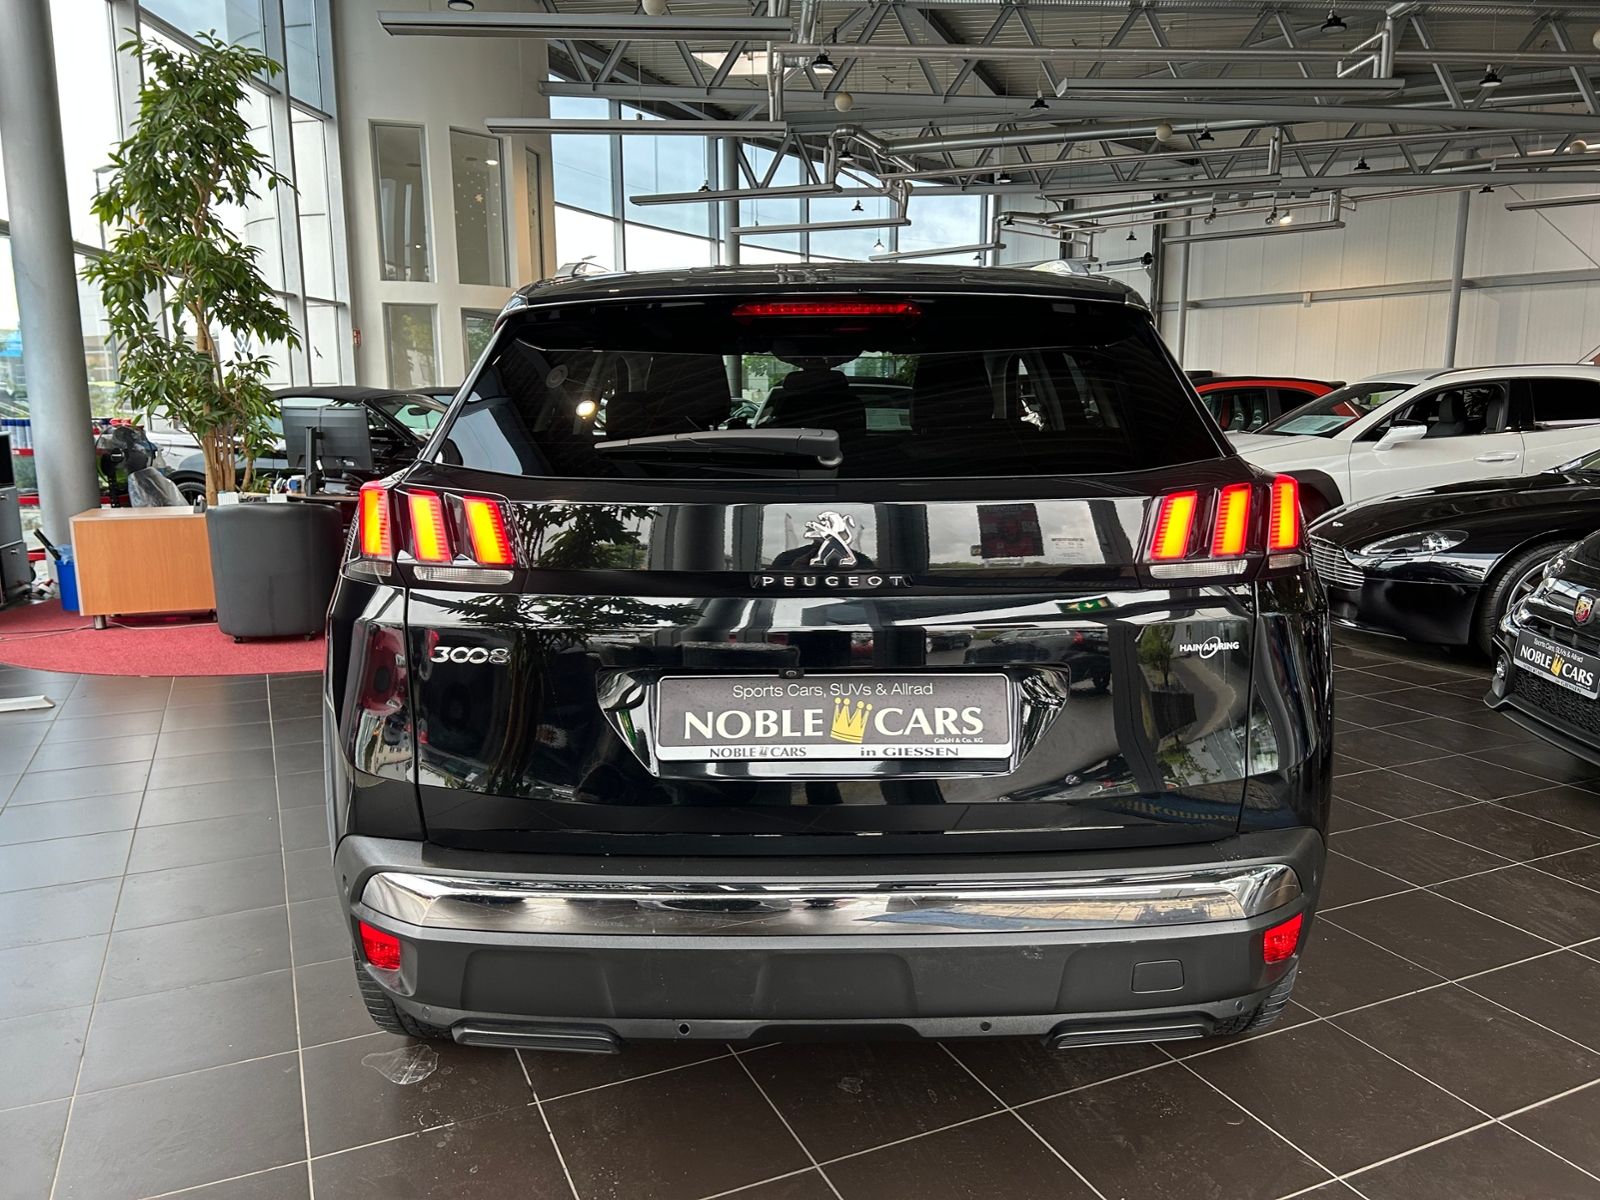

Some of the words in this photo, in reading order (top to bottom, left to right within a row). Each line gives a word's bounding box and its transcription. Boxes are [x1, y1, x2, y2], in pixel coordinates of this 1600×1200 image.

[762, 576, 903, 587] PEUGEOT
[1179, 643, 1203, 652] HAIN
[1218, 641, 1240, 650] RING
[430, 646, 512, 665] 3008
[1520, 644, 1552, 669] NOBLE
[1562, 663, 1594, 686] CARS
[732, 685, 784, 699] Sports
[787, 683, 827, 698] Cars,
[830, 683, 872, 696] SUVs
[875, 683, 887, 696] &
[891, 682, 934, 695] Allrad
[684, 709, 823, 740] NOBLE
[874, 707, 984, 736] CARS
[709, 748, 756, 758] NOBLE
[770, 747, 807, 757] CARS
[860, 747, 876, 757] in
[883, 747, 959, 756] GIESSEN
